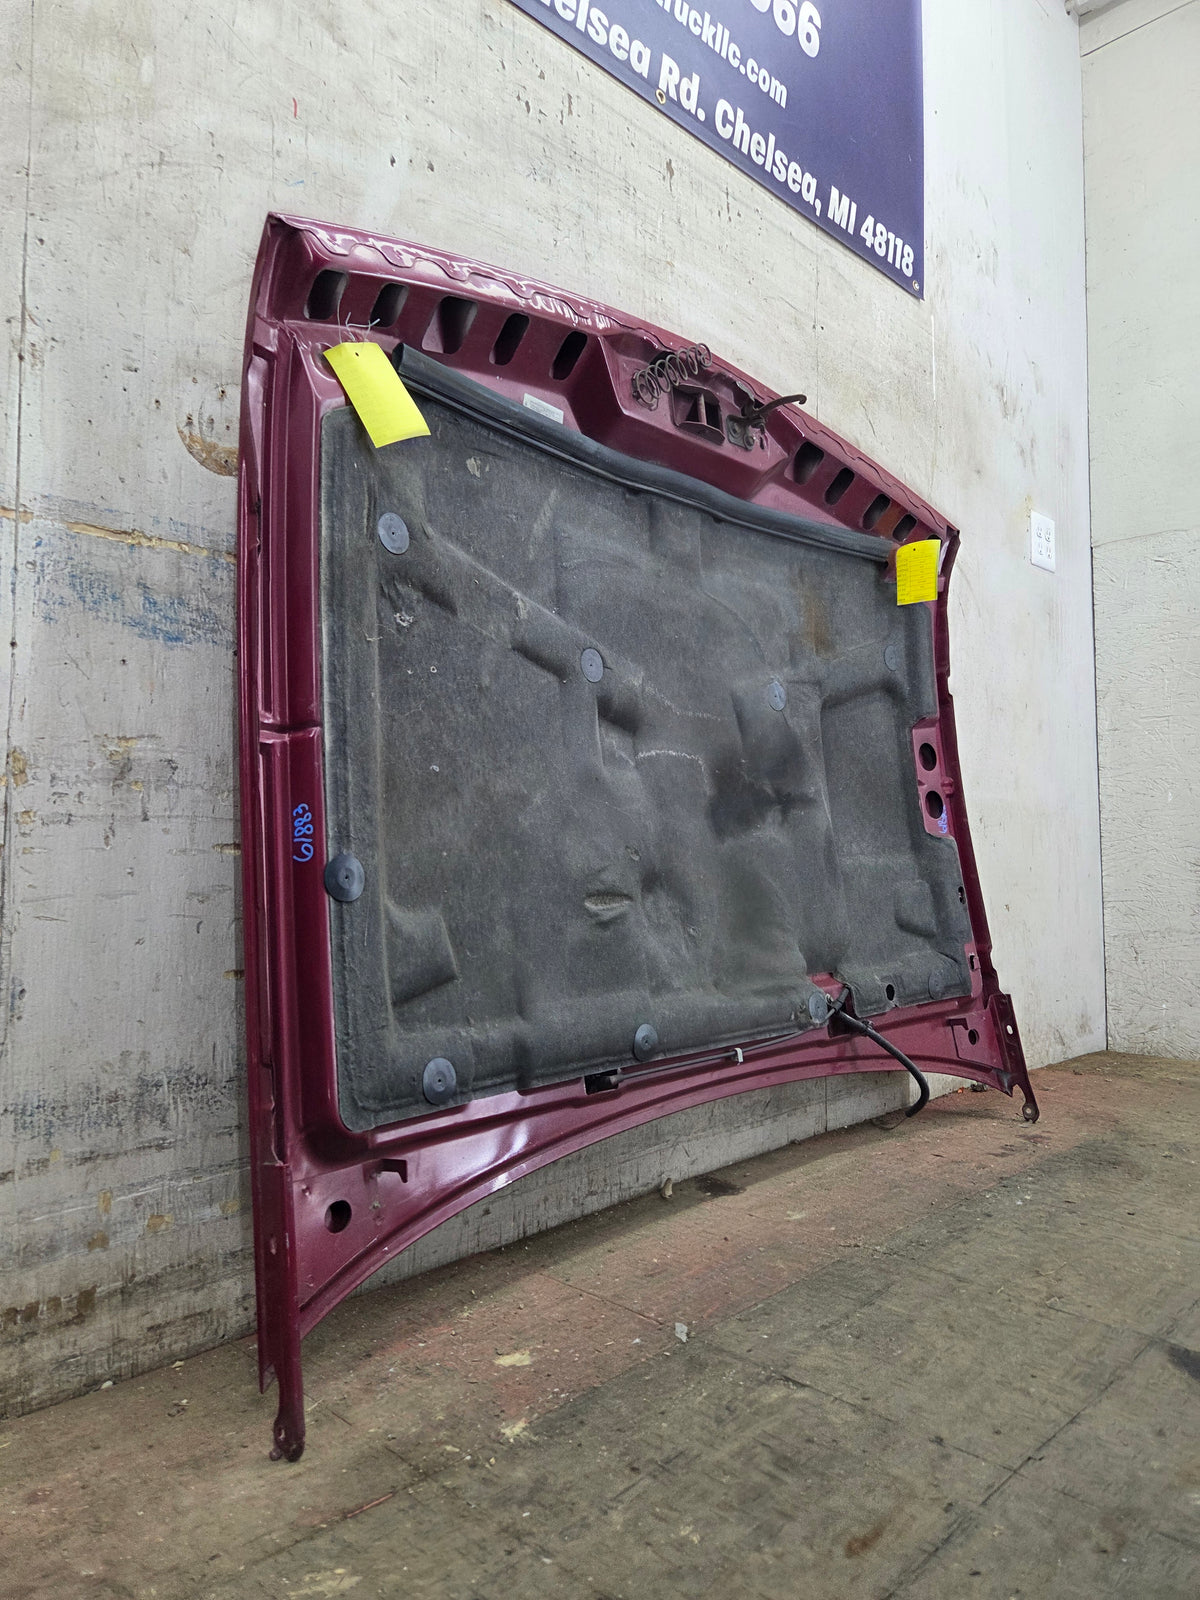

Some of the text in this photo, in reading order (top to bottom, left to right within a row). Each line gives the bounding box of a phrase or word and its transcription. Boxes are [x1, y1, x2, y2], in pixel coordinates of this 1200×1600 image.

[655, 0, 788, 109] uckllc.com
[751, 0, 822, 58] 66
[541, 0, 914, 278] elsea Rd. Chelsea, MI 48118
[292, 803, 314, 862] 61883
